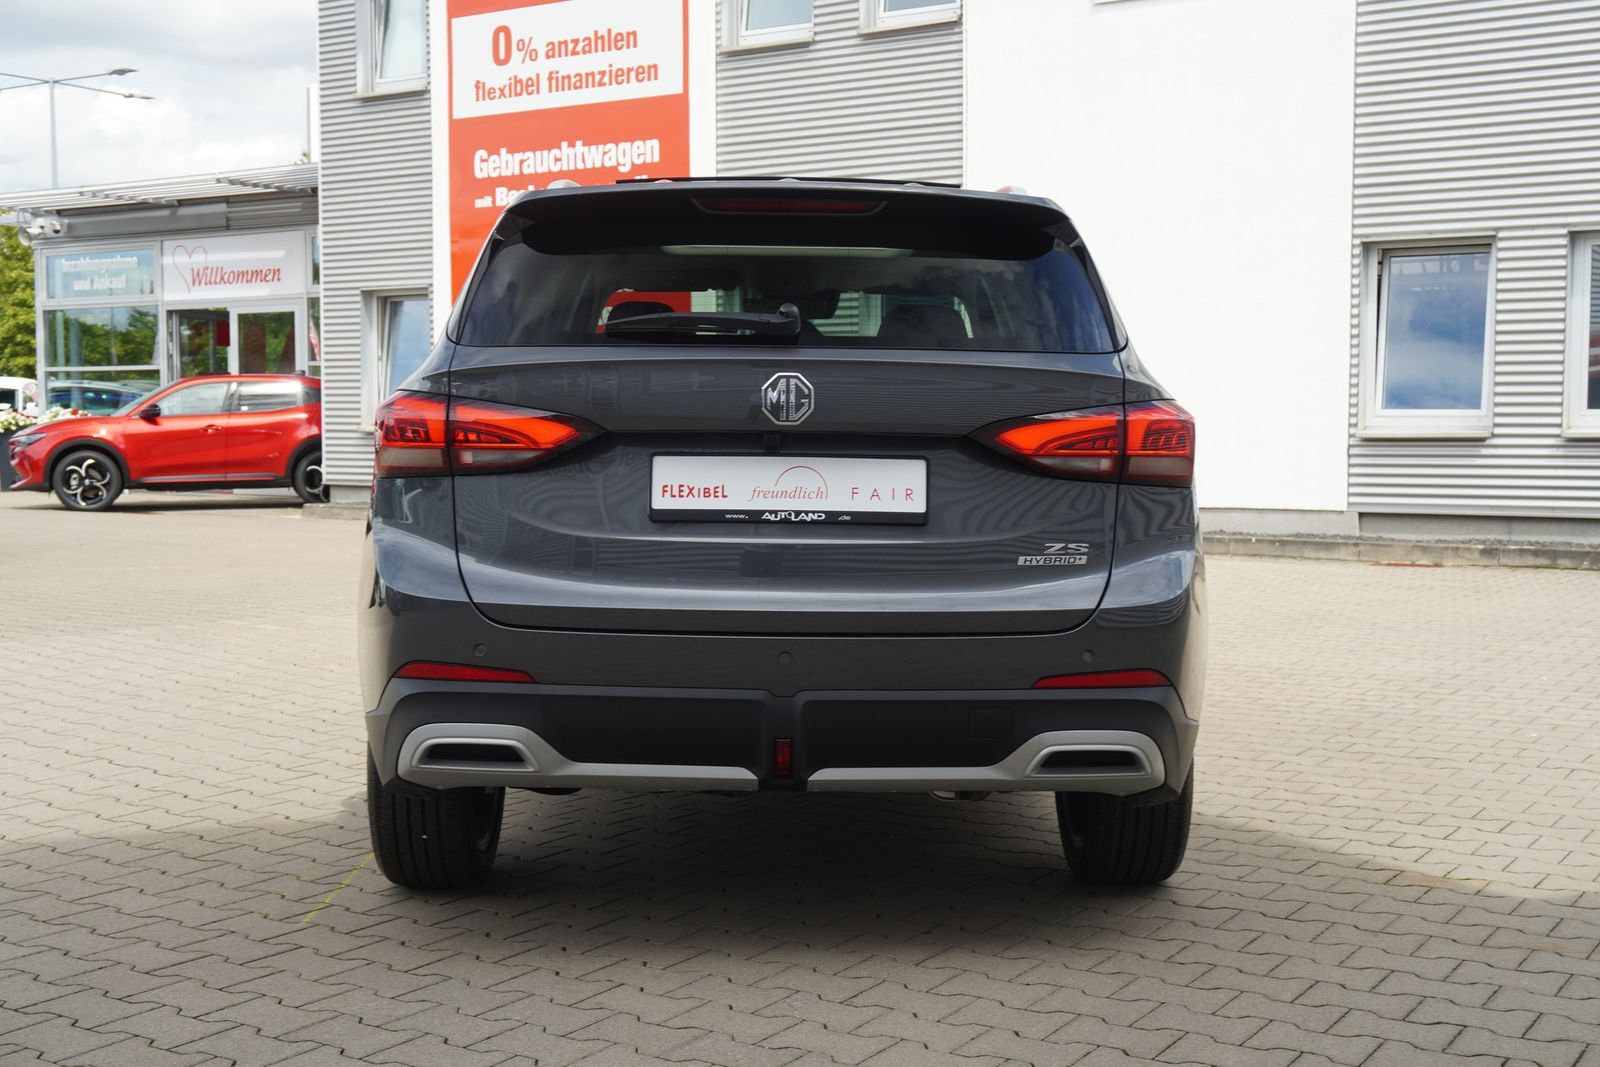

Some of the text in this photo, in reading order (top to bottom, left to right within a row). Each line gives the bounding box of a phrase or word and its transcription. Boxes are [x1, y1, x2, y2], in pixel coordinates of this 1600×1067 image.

[544, 28, 638, 60] anzahlen
[474, 62, 659, 102] flexibel finanzieren
[473, 138, 660, 179] Gebrauchtwagen
[190, 265, 282, 287] Willkommen
[766, 377, 810, 421] MG
[661, 483, 914, 502] FLEXIBEL freundlich FAIR
[1043, 543, 1090, 554] ZS
